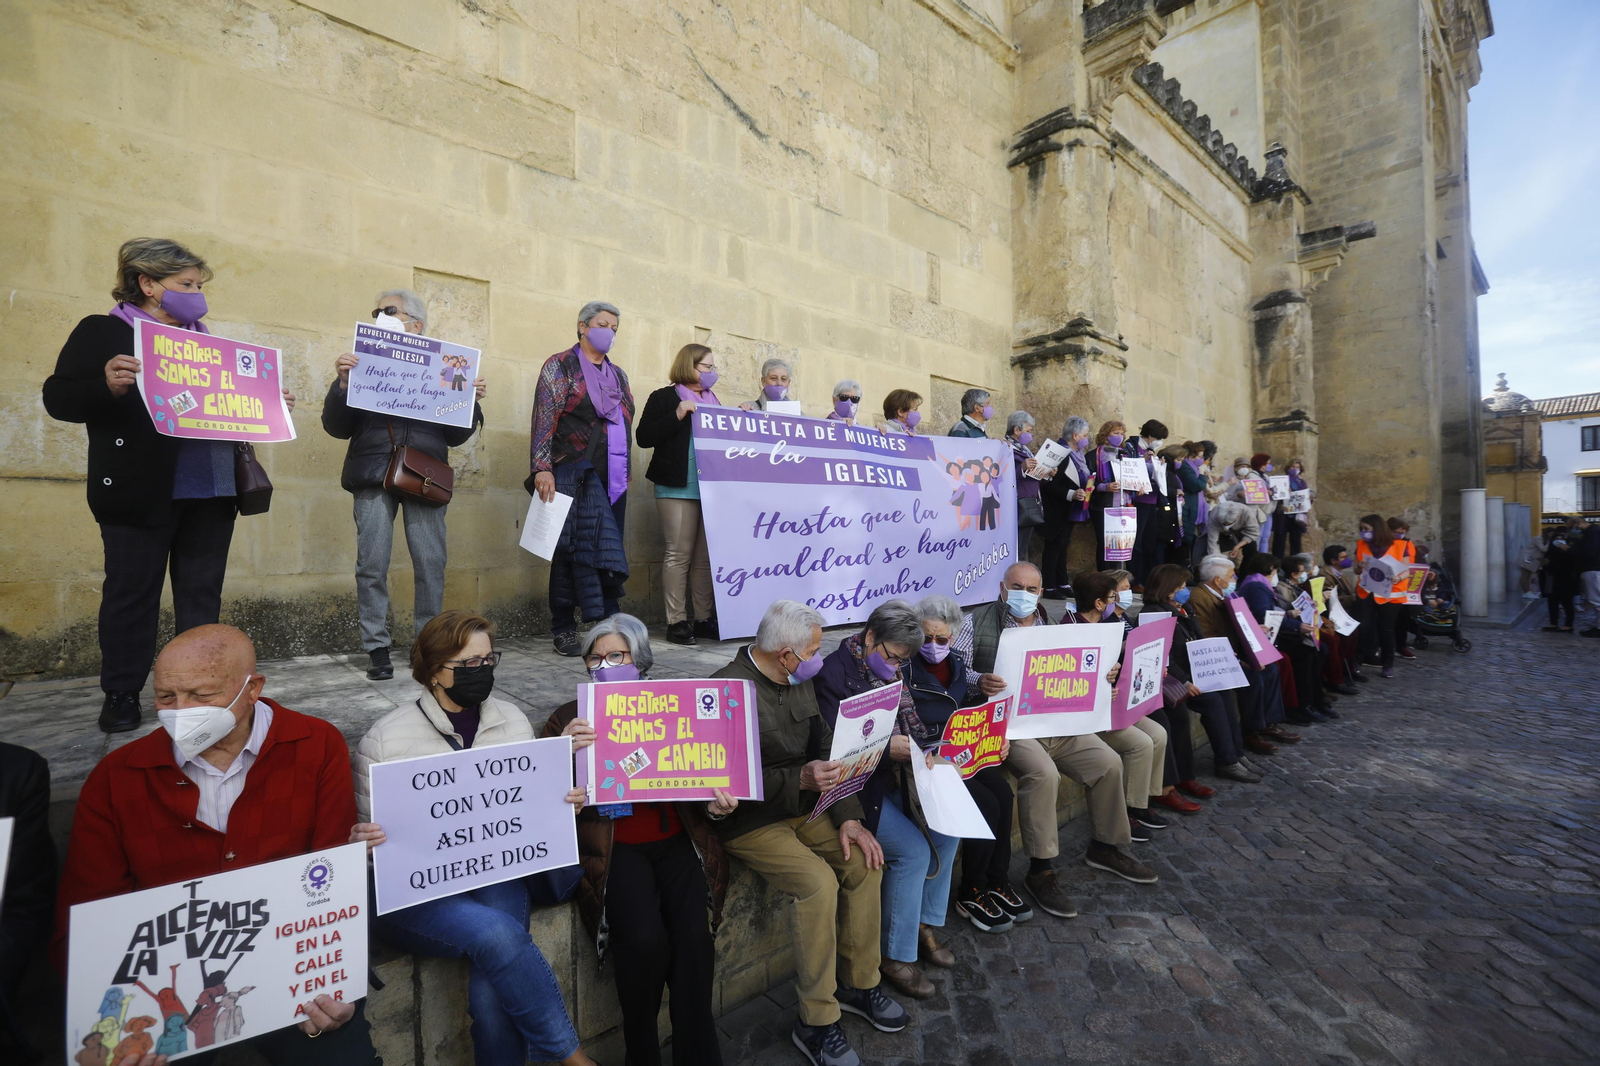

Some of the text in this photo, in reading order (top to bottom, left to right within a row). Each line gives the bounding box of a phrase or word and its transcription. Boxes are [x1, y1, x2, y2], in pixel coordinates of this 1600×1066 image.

[153, 335, 222, 365] NOSOTRAS
[359, 327, 430, 348] REVUELTA DE MUJERES
[392, 349, 425, 364] IGLESIA
[156, 358, 235, 390] SOMOS EL
[365, 365, 434, 381] Hasta que la
[353, 381, 446, 400] igualdad se haga
[204, 393, 264, 419] CAMBIO
[376, 398, 427, 411] costumbre
[435, 399, 468, 418] Córdoba
[196, 421, 248, 432] CÓRDOBA
[700, 412, 907, 452] REVUELTA DE MUJERES
[725, 439, 807, 465] en la
[824, 462, 908, 488] IGLESIA
[753, 498, 939, 540] Hasta que la
[715, 527, 973, 597] igualdad se haga
[953, 542, 1010, 596] Córdoba
[806, 567, 936, 611] costumbre
[1028, 653, 1077, 677] DIGNIDAD
[1036, 675, 1090, 700] E IGUALDAD
[605, 690, 679, 717] NOSOTRAS
[607, 717, 694, 744] SOMOS EL
[949, 722, 989, 746] SOMOS EL
[657, 742, 726, 772] CAMBIO
[411, 755, 537, 791] CON VOTO,
[648, 778, 705, 788] CÓRDOBA
[430, 786, 523, 820] CON VOZ
[436, 817, 523, 850] ASI NOS
[300, 858, 319, 882] Mujeres
[320, 856, 334, 882] Cristianas
[409, 841, 549, 890] QUIERE DIOS
[127, 898, 270, 951] ALCEMOS
[275, 905, 360, 940] IGUALDAD
[296, 930, 342, 955] EN LA
[111, 928, 262, 985] LA VOZ
[294, 949, 343, 976] CALLE
[289, 968, 348, 998] Y EN EL
